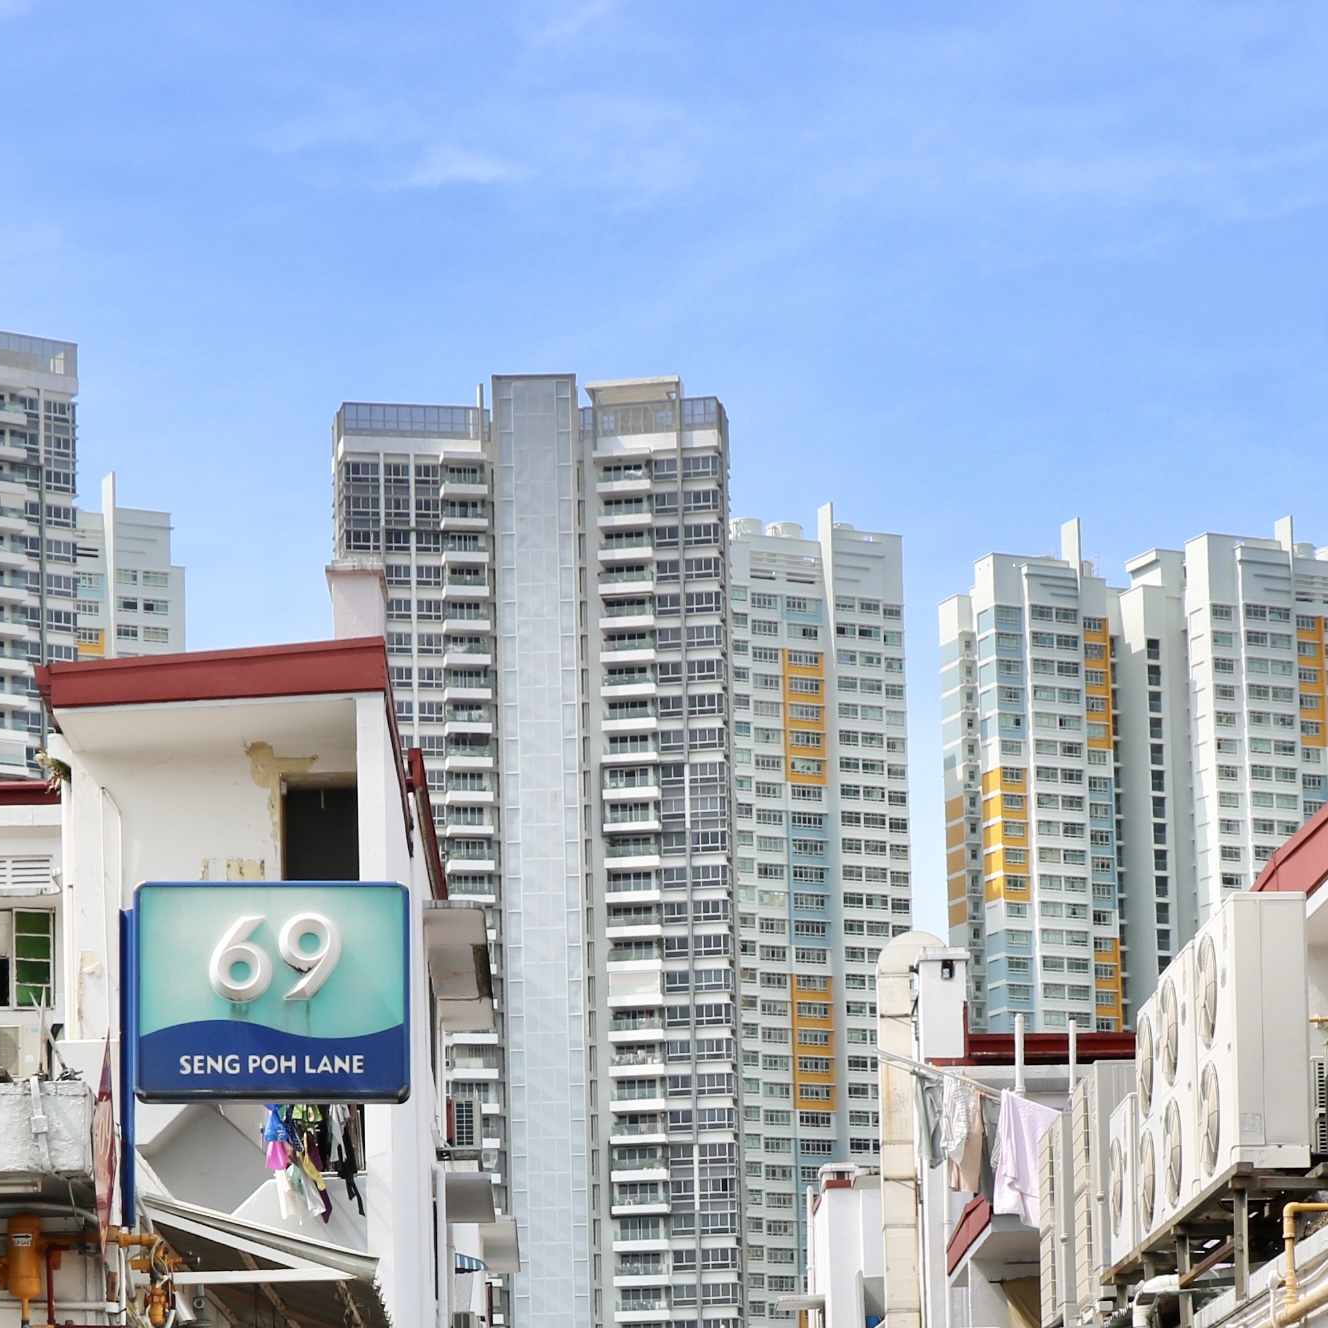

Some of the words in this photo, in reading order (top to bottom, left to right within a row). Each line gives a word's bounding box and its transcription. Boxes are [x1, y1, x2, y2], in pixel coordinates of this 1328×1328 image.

[209, 912, 342, 1003] 69
[179, 1054, 240, 1075] SENG
[248, 1054, 297, 1074] POH
[305, 1054, 365, 1074] LANE
